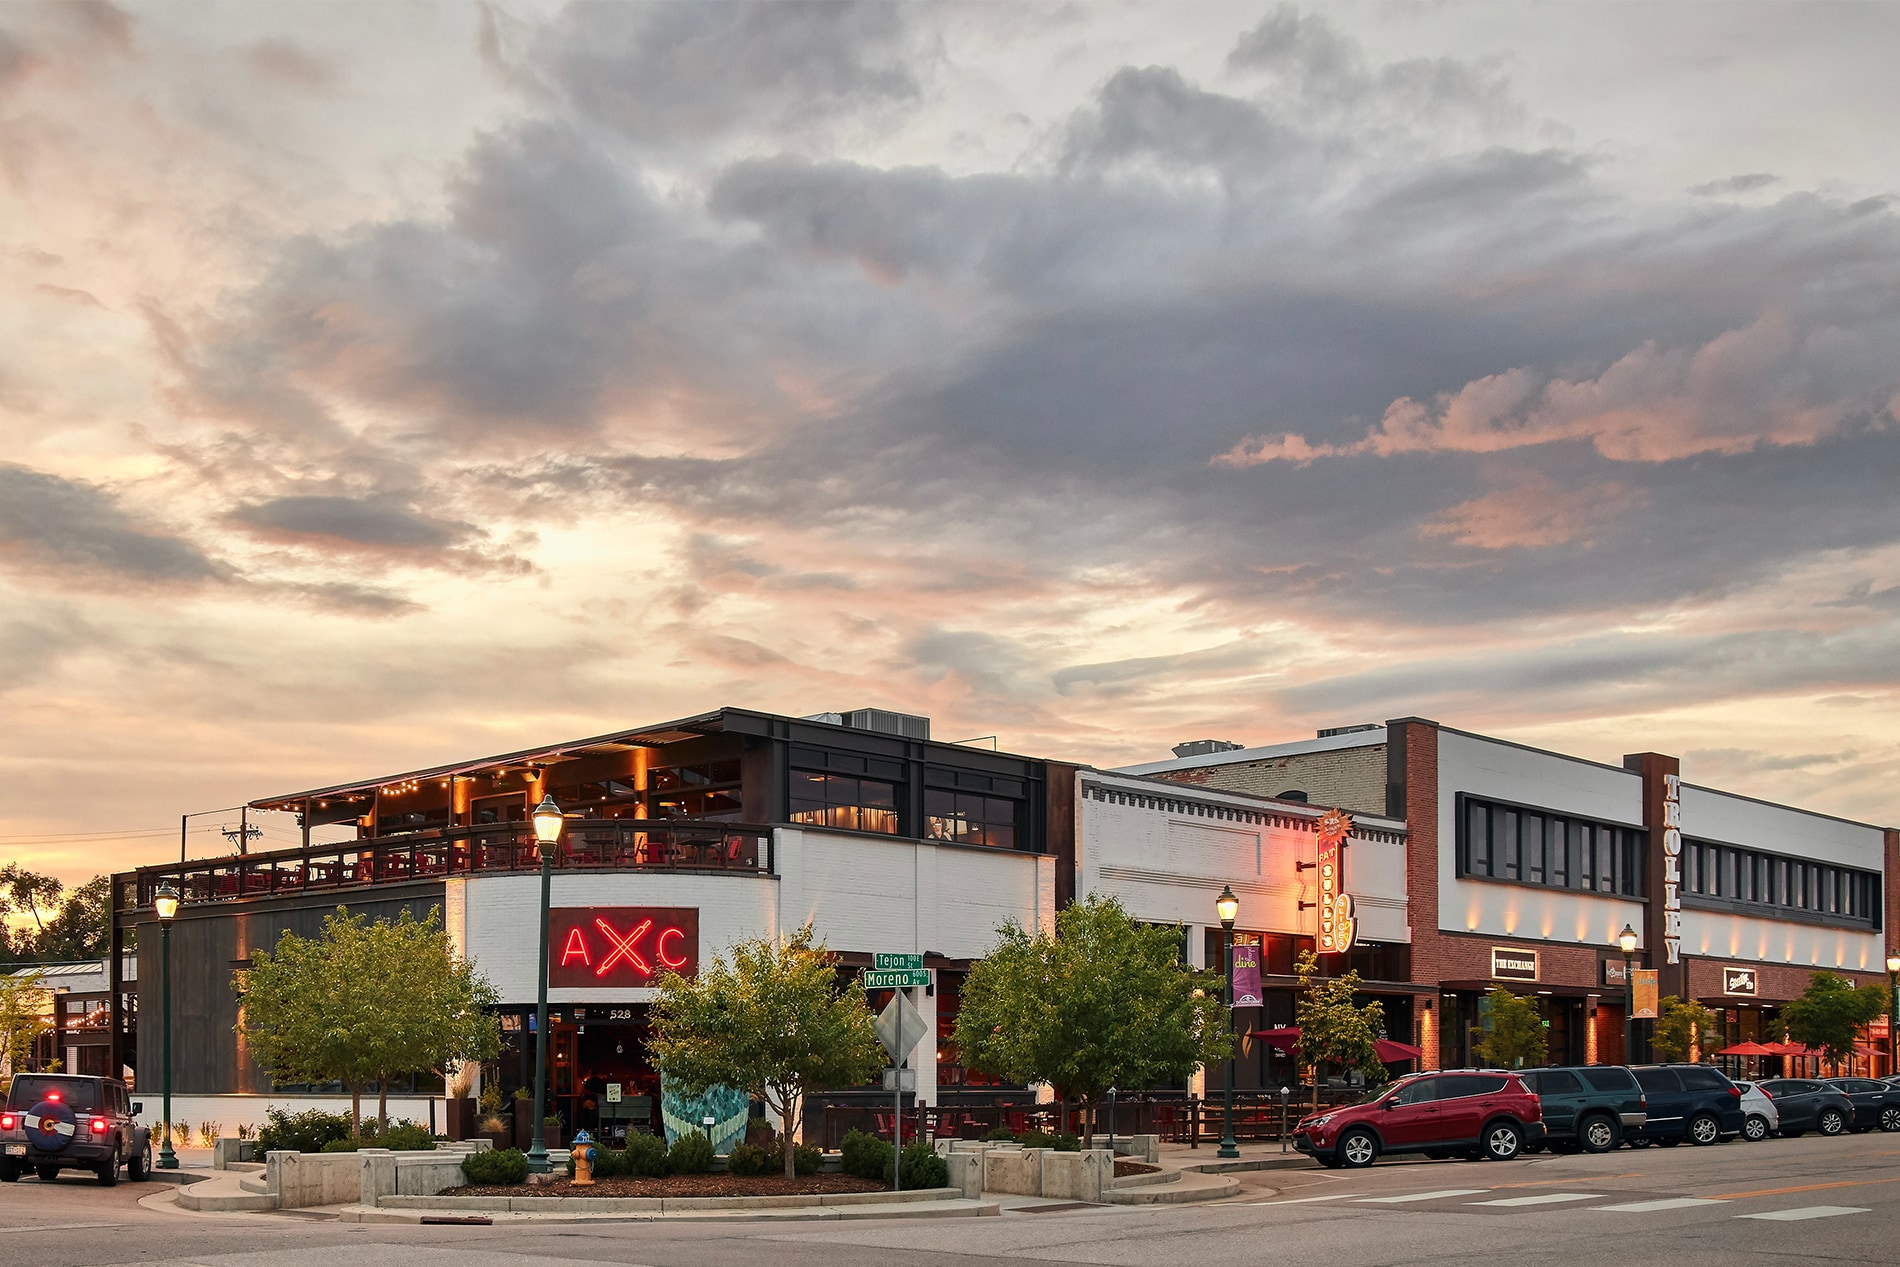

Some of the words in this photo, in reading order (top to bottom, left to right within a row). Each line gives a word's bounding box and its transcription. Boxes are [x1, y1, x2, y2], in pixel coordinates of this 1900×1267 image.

[1319, 848, 1336, 863] FAT
[1663, 773, 1681, 965] TROLLEY
[1337, 899, 1345, 947] SLICES
[879, 954, 905, 969] Tejon
[1235, 954, 1256, 968] dine
[1496, 959, 1506, 969] THE
[1508, 960, 1534, 971] EXCHANGE
[868, 974, 908, 986] Moreno
[610, 1009, 631, 1020] 528
